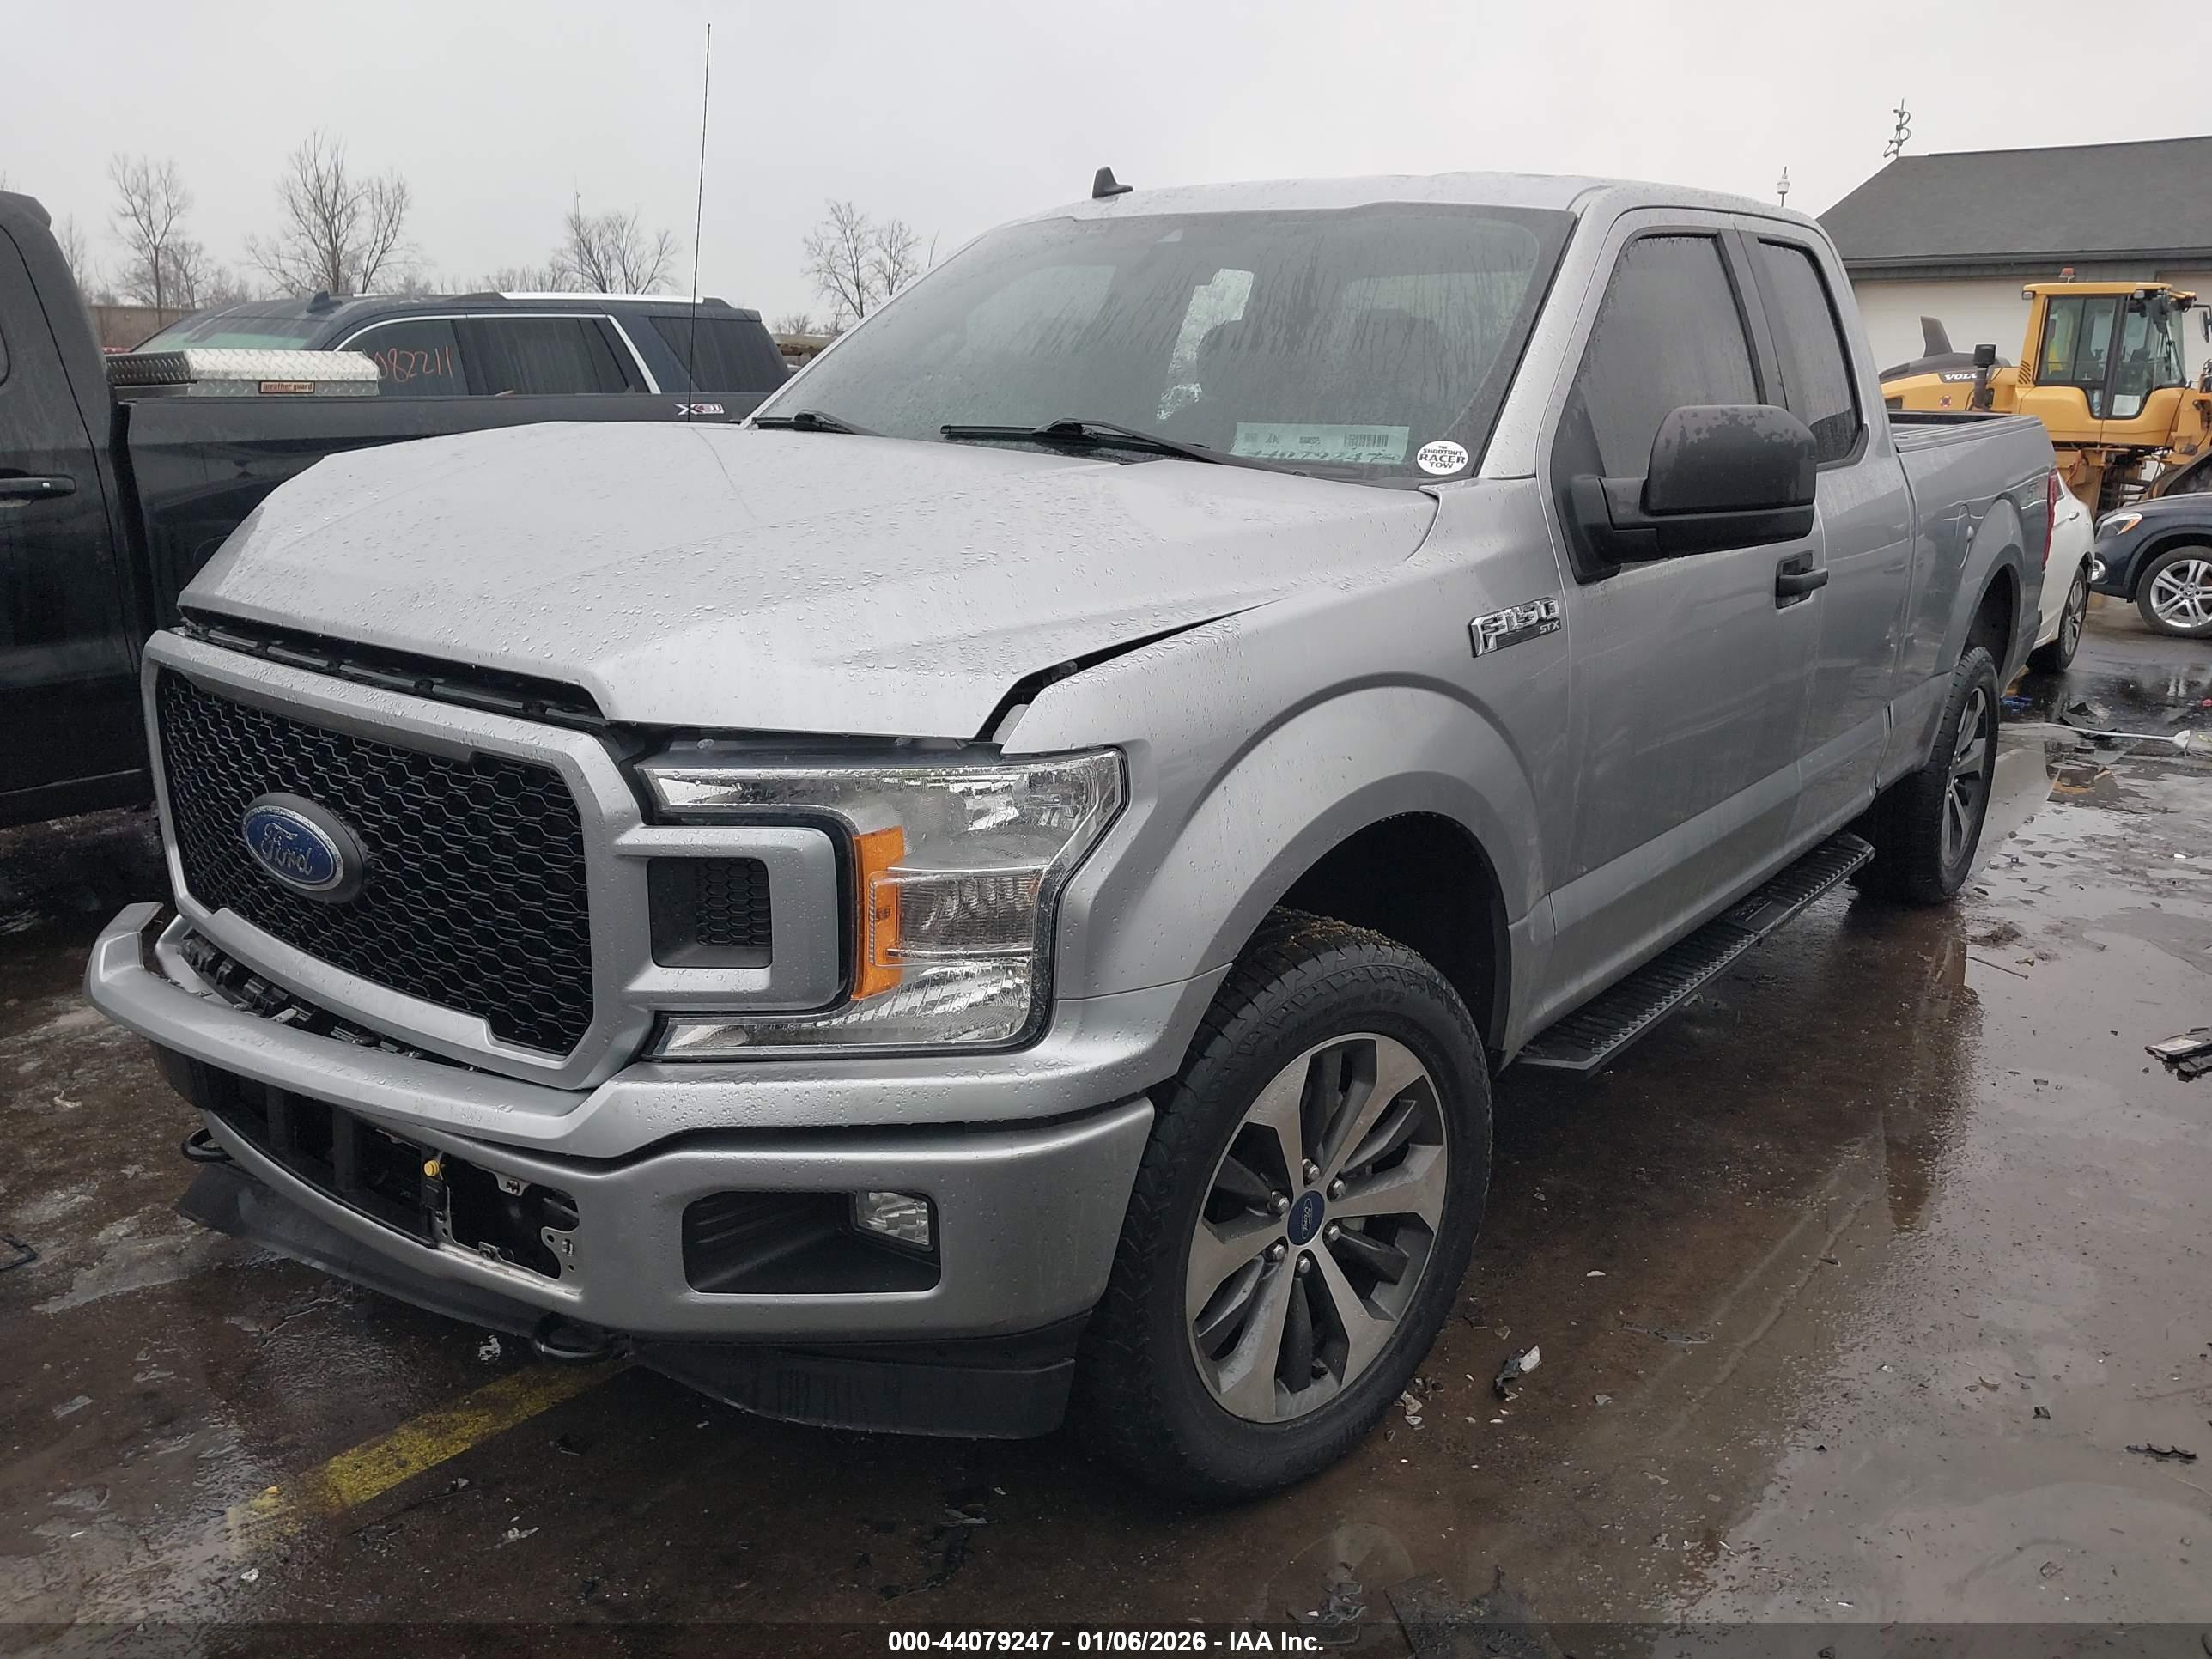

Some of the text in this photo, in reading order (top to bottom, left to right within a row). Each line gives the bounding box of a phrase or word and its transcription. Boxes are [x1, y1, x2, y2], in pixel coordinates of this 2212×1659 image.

[1419, 453, 1466, 464] RACER
[1540, 620, 1560, 635] STX
[260, 822, 313, 876] Ford
[1303, 1206, 1311, 1231] Ford
